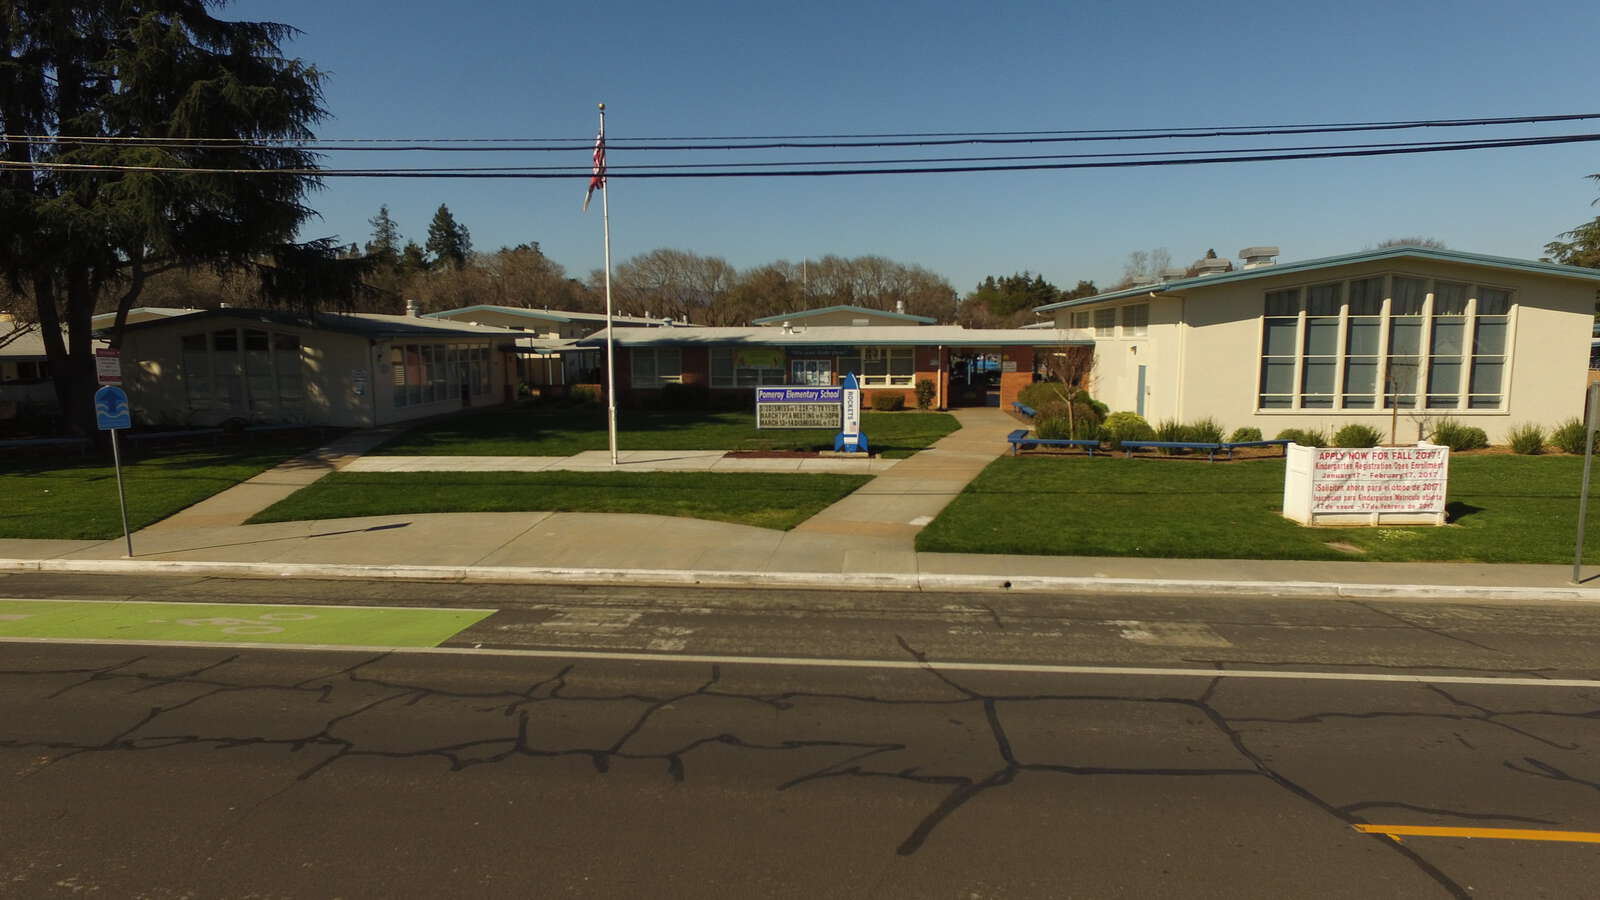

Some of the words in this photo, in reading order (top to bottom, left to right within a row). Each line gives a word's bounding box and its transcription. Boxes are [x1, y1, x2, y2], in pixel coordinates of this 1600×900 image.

[760, 390, 784, 400] Pomeroy
[786, 390, 818, 400] Elementary
[820, 390, 840, 398] School
[1319, 452, 1344, 460] APPLY
[1348, 452, 1368, 460] NOW
[1372, 452, 1388, 460] FOR
[1392, 452, 1412, 460] FALL
[1316, 462, 1352, 471] Kindergarten
[1355, 462, 1392, 471] Registration
